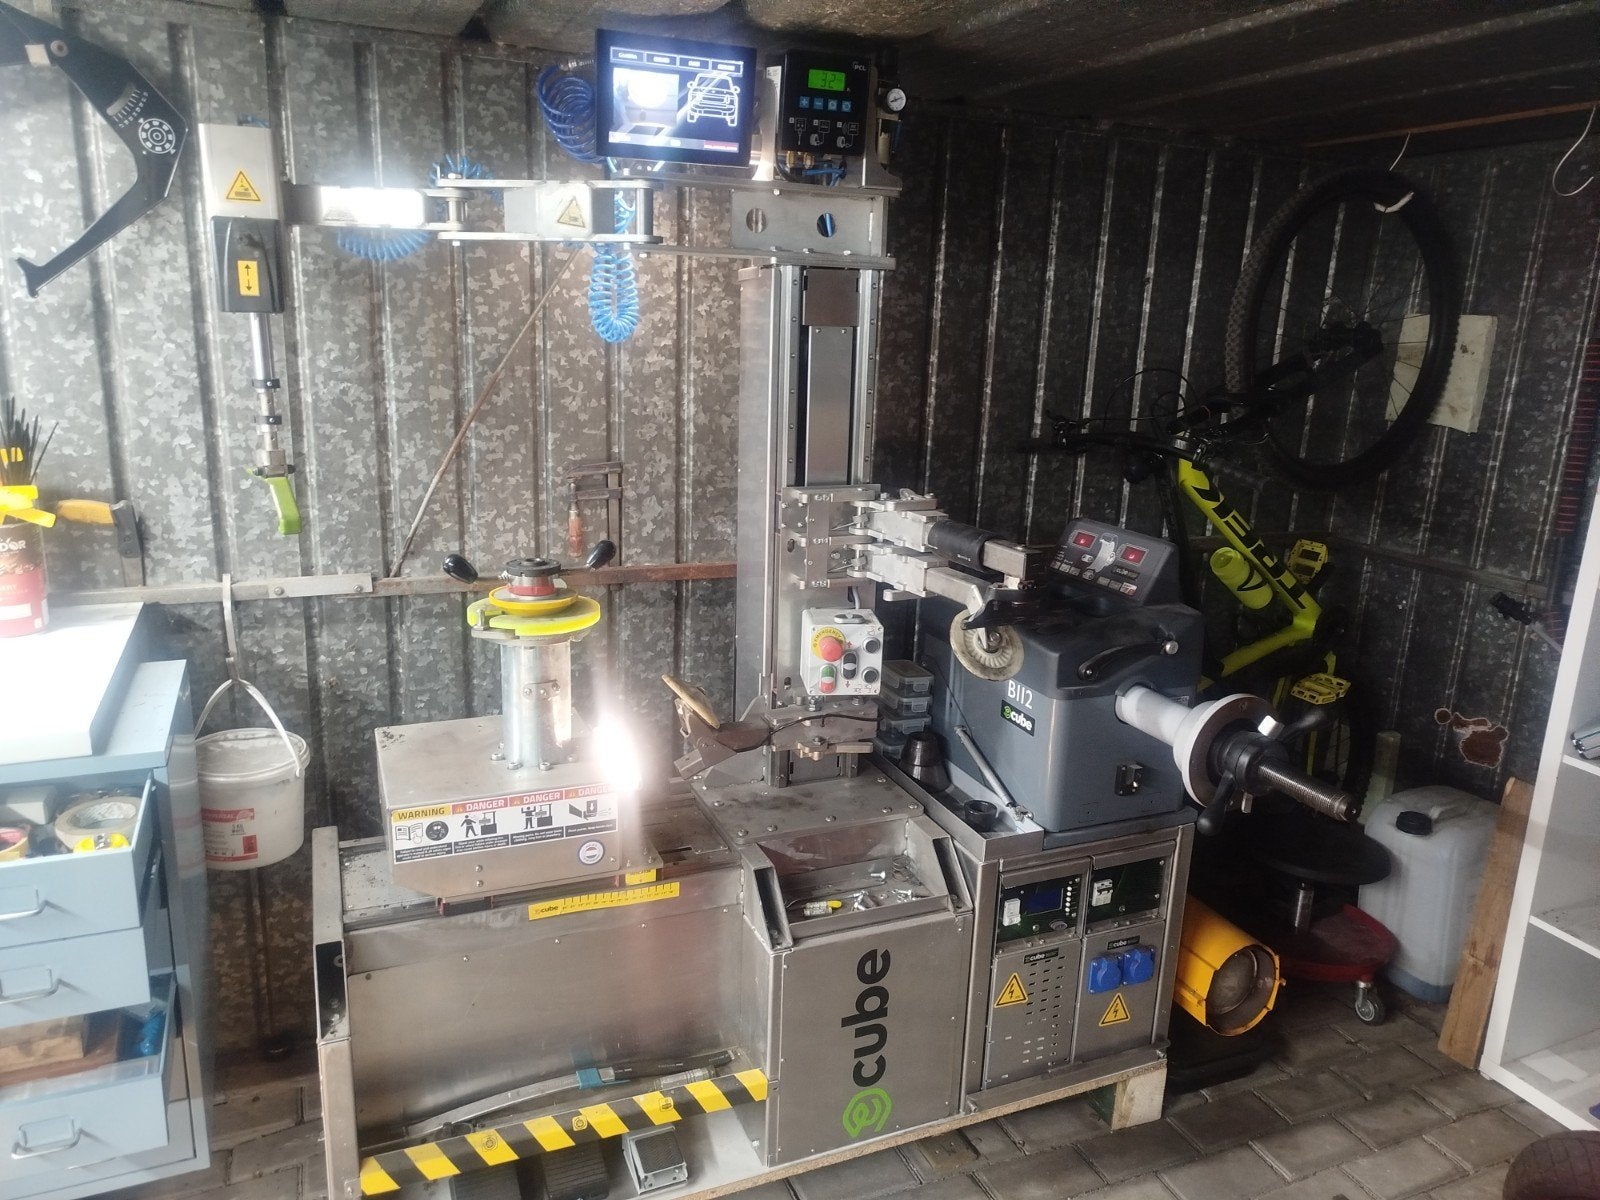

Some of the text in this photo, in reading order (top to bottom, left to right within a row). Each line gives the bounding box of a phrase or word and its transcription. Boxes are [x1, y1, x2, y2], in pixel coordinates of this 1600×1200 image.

[854, 64, 867, 72] PCL
[1190, 483, 1308, 610] TREK
[1010, 711, 1033, 731] cube
[523, 791, 561, 805] DANGER
[466, 799, 505, 812] DANGER
[398, 807, 445, 820] WARNING
[540, 904, 559, 913] cube
[841, 948, 891, 1088] cube
